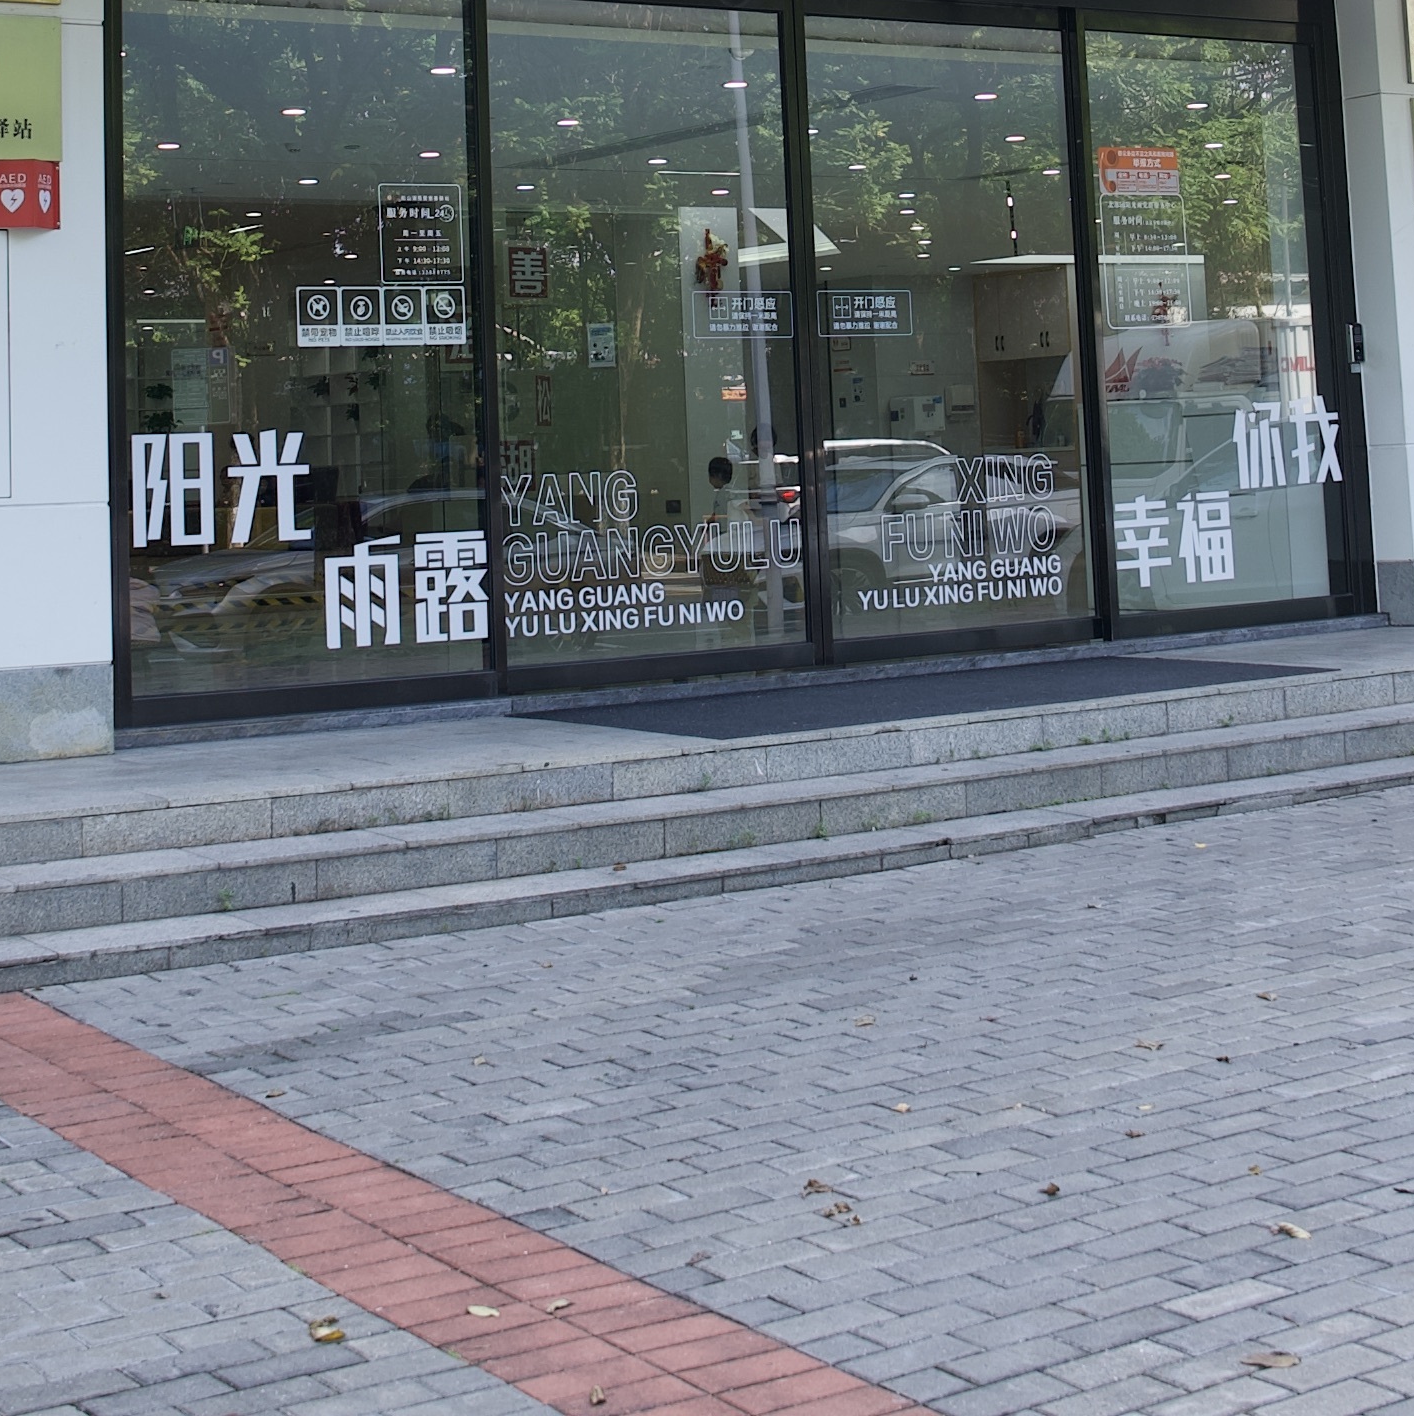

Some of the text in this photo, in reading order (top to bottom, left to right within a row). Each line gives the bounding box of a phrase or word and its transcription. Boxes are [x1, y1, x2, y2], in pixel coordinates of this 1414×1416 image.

[0, 173, 26, 184] AED
[38, 173, 52, 185] AED
[731, 297, 777, 311] 开门感应
[853, 296, 896, 309] 开门感应
[1233, 395, 1342, 489] 你我
[131, 428, 312, 548] 阳光
[501, 470, 638, 526] YANG
[956, 453, 1054, 504] XING
[502, 518, 802, 586] GUANGYULU
[881, 505, 1056, 563] FU NI WO
[1114, 490, 1235, 587] 幸福
[324, 530, 489, 650] 雨露
[928, 554, 1062, 583] YANG GUANG
[504, 583, 665, 613] YANG GUANG
[857, 576, 1063, 611] YU LU XING FU NI WO
[505, 599, 744, 638] YU LU XING FU NI WO
